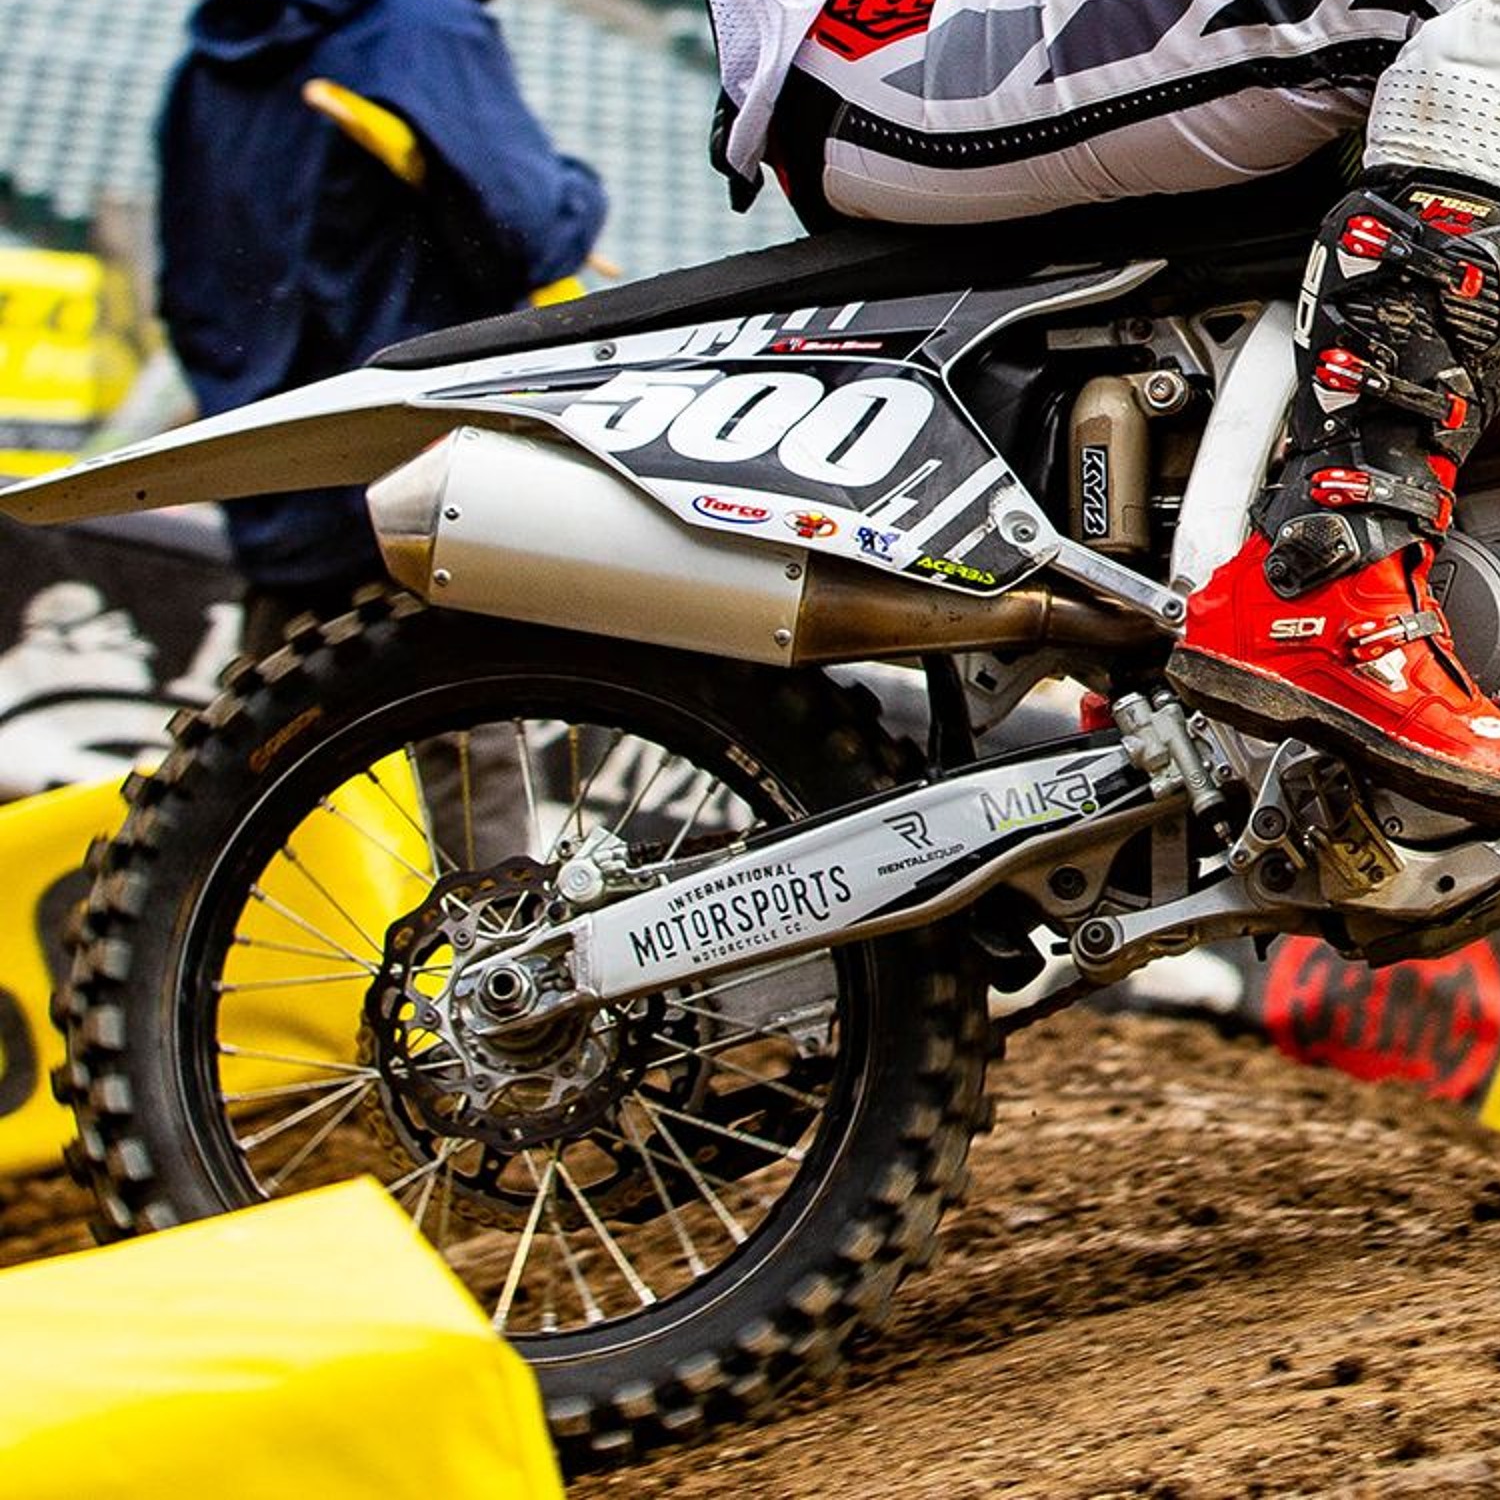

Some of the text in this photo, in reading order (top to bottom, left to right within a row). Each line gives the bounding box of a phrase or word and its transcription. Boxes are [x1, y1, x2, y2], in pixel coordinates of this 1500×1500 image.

[561, 369, 935, 487] 500
[703, 496, 767, 519] Torco
[1083, 447, 1107, 535] KYB
[630, 865, 852, 967] MOTORSPORTS
[667, 862, 797, 912] INTERNATIONAL
